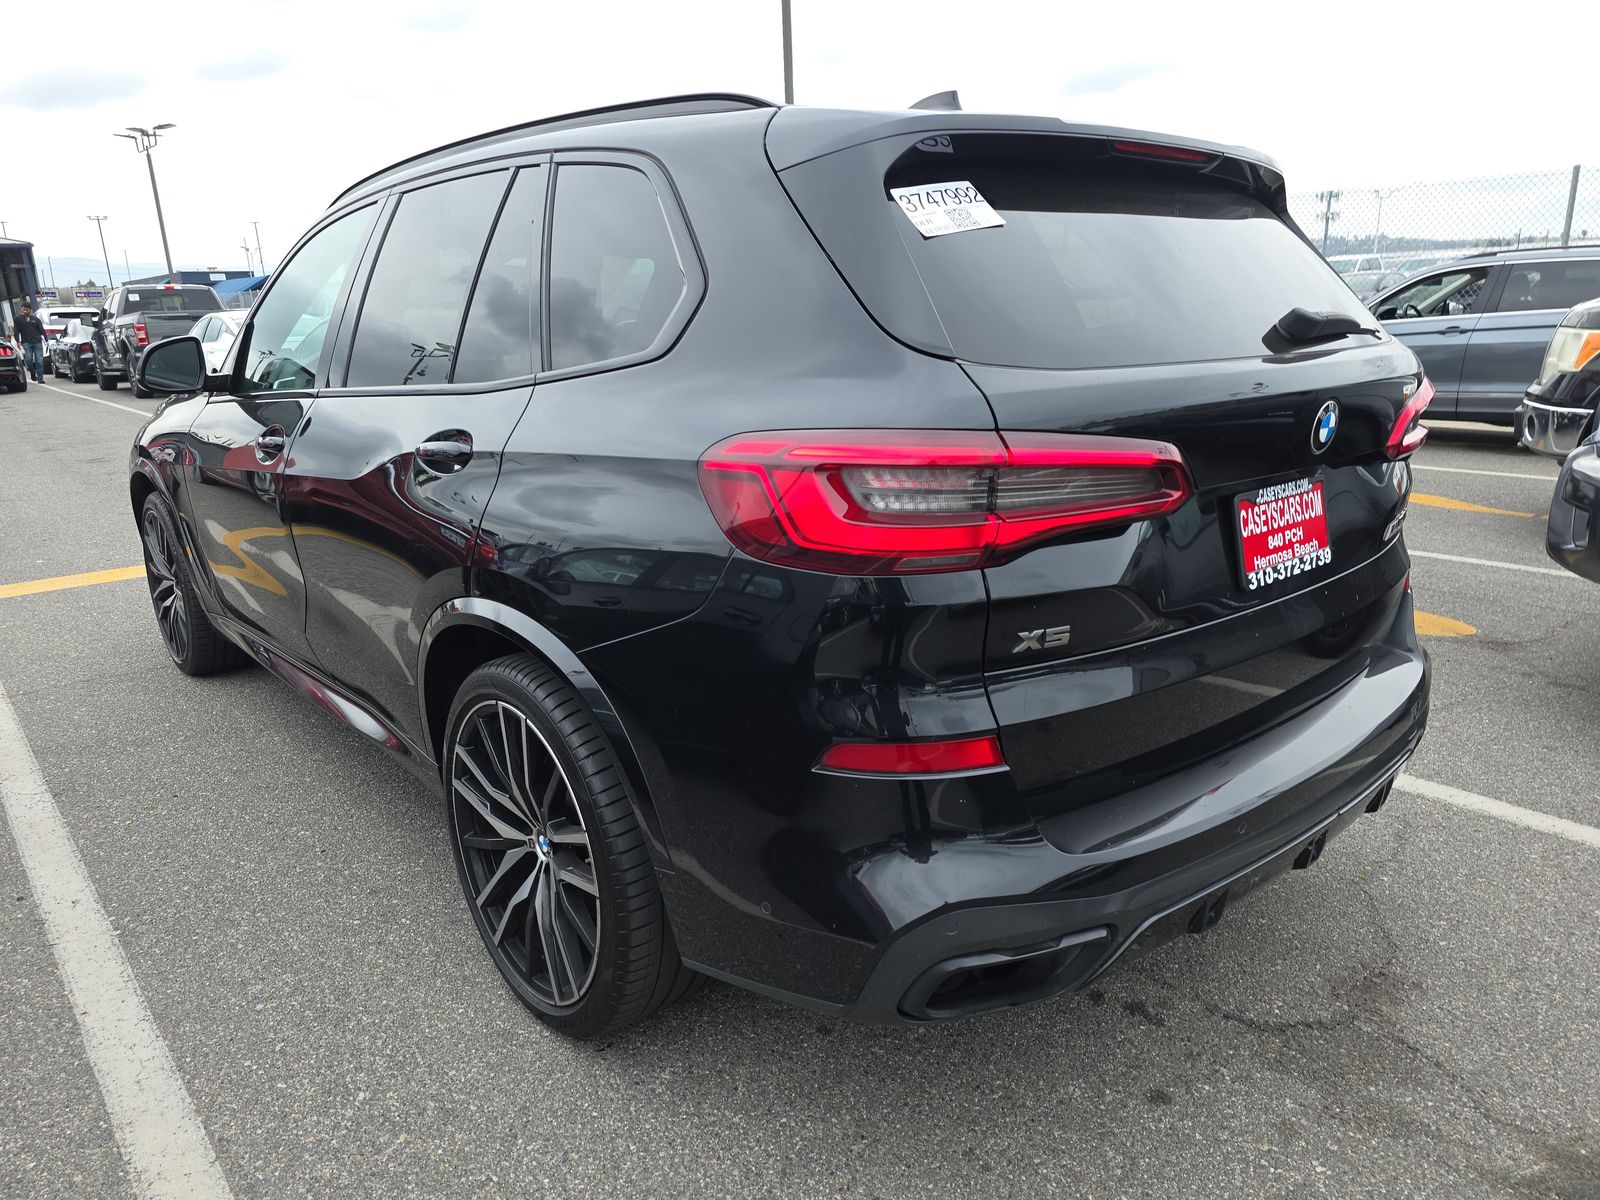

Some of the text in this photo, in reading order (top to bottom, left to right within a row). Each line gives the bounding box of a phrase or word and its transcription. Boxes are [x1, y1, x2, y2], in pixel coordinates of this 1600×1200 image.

[899, 186, 985, 212] 3747992
[1258, 478, 1309, 504] CASEYSCARS.COM
[1240, 490, 1323, 538] CASEYSCARS.COM
[1268, 526, 1304, 550] 840 PCH
[1248, 547, 1332, 590] 310-372-2739
[1254, 538, 1319, 570] Hermosa Beach
[1012, 625, 1071, 654] X5
